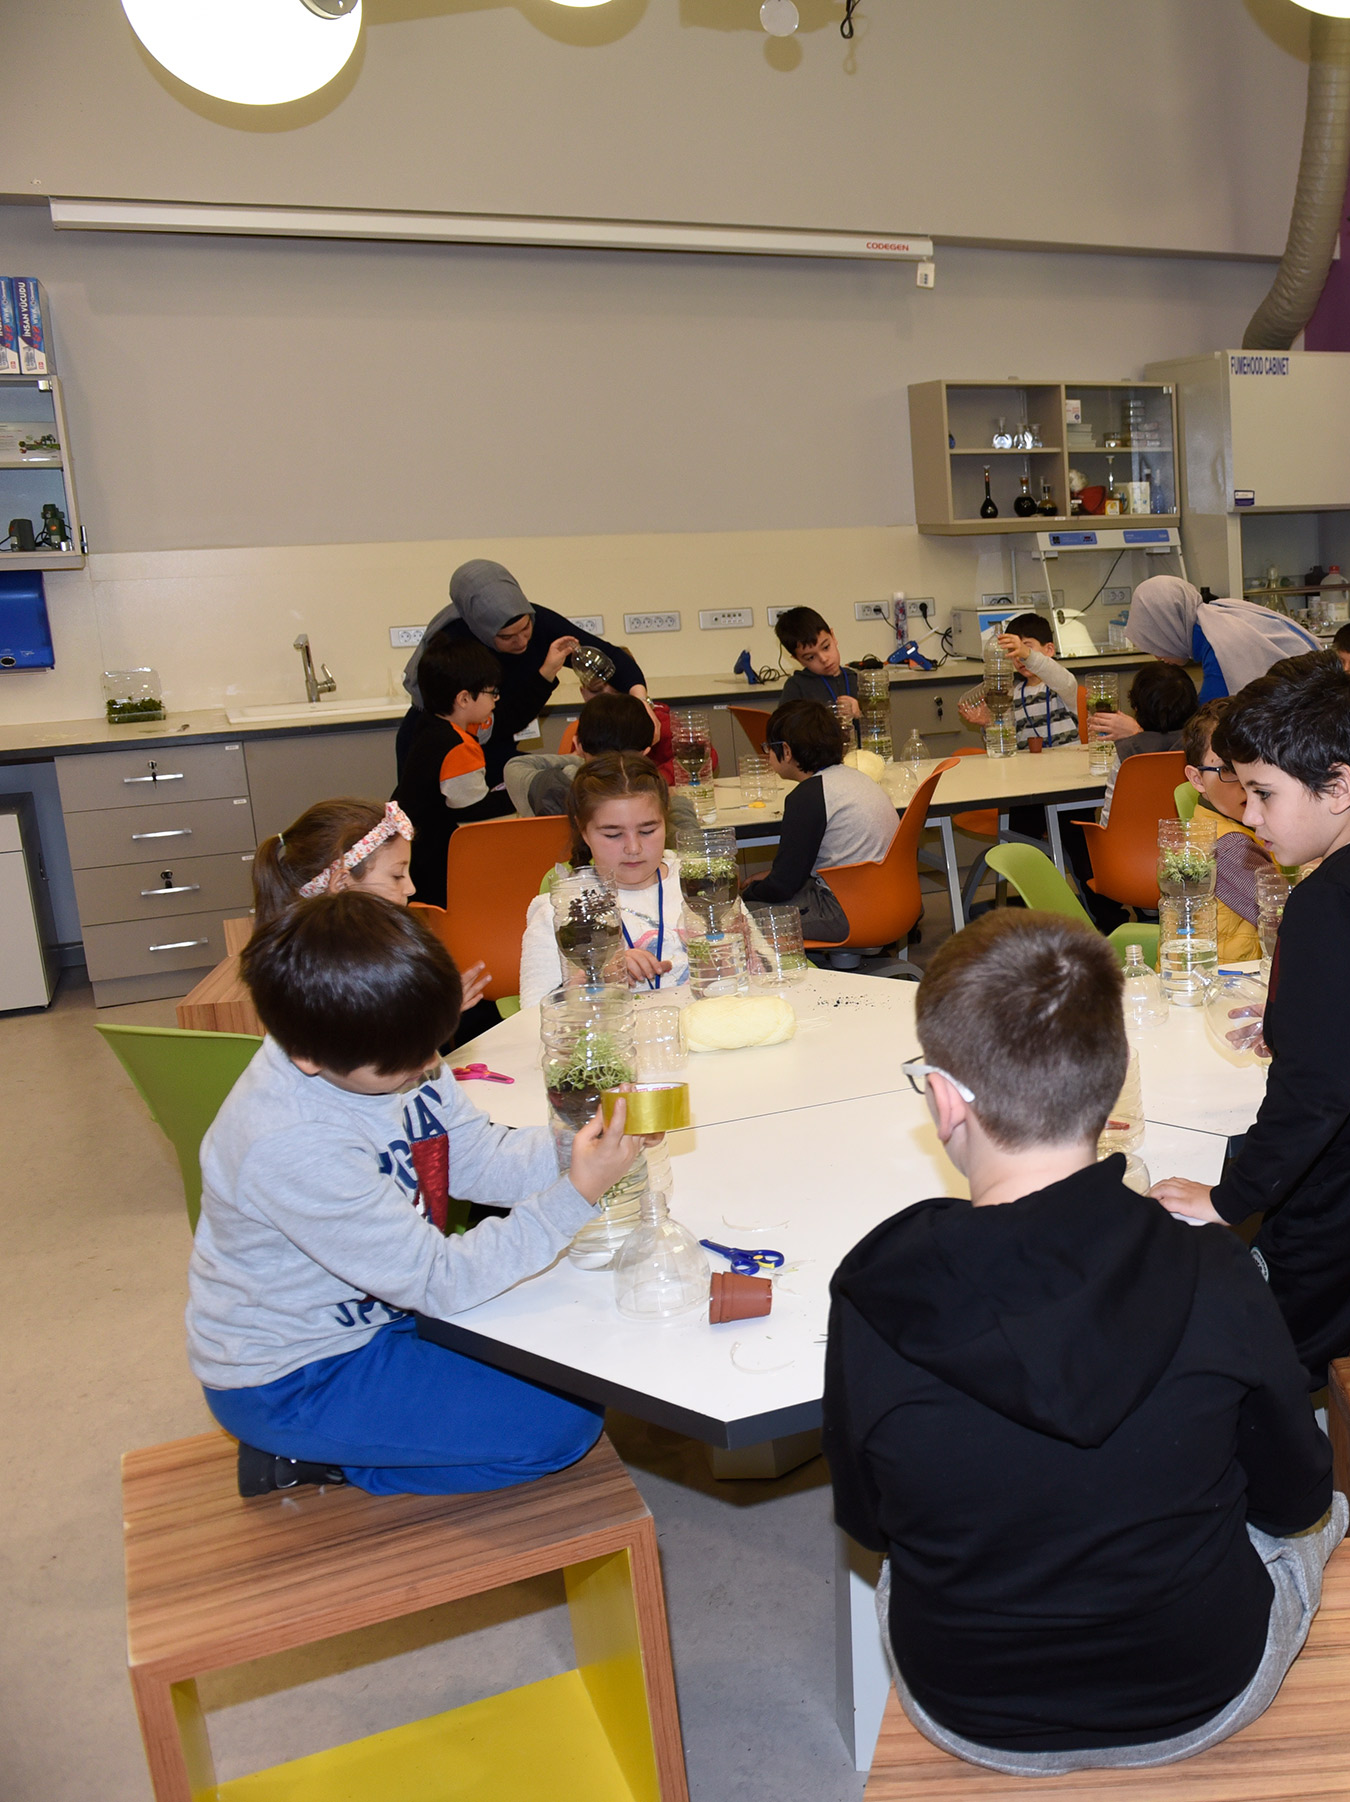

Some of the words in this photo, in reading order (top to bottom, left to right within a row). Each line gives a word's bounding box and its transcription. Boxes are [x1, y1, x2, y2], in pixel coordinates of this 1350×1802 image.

[866, 241, 909, 251] CODEGEN
[1231, 356, 1263, 375] FUMEHOOD
[1265, 356, 1289, 375] CABINET
